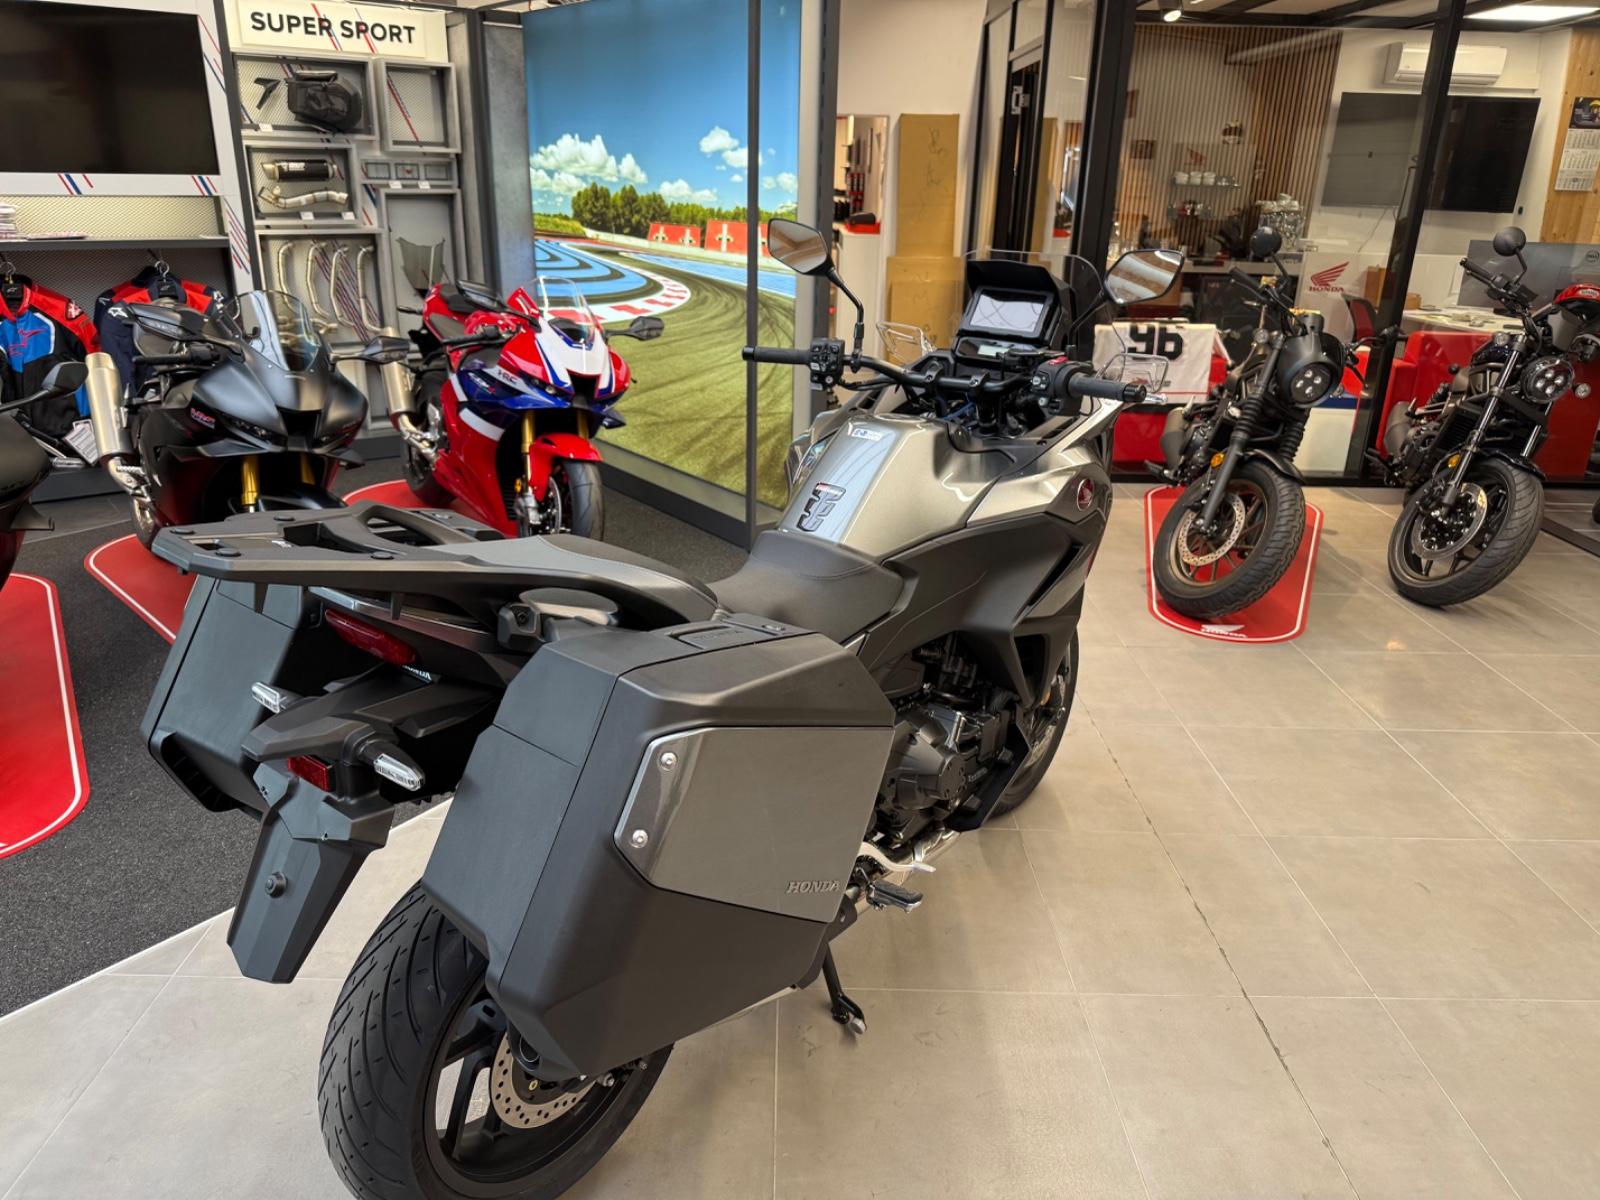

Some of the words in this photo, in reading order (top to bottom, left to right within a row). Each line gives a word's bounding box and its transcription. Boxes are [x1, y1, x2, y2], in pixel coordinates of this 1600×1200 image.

[250, 11, 333, 38] SUPER
[340, 19, 415, 43] SPORT
[786, 880, 840, 894] HONDA
